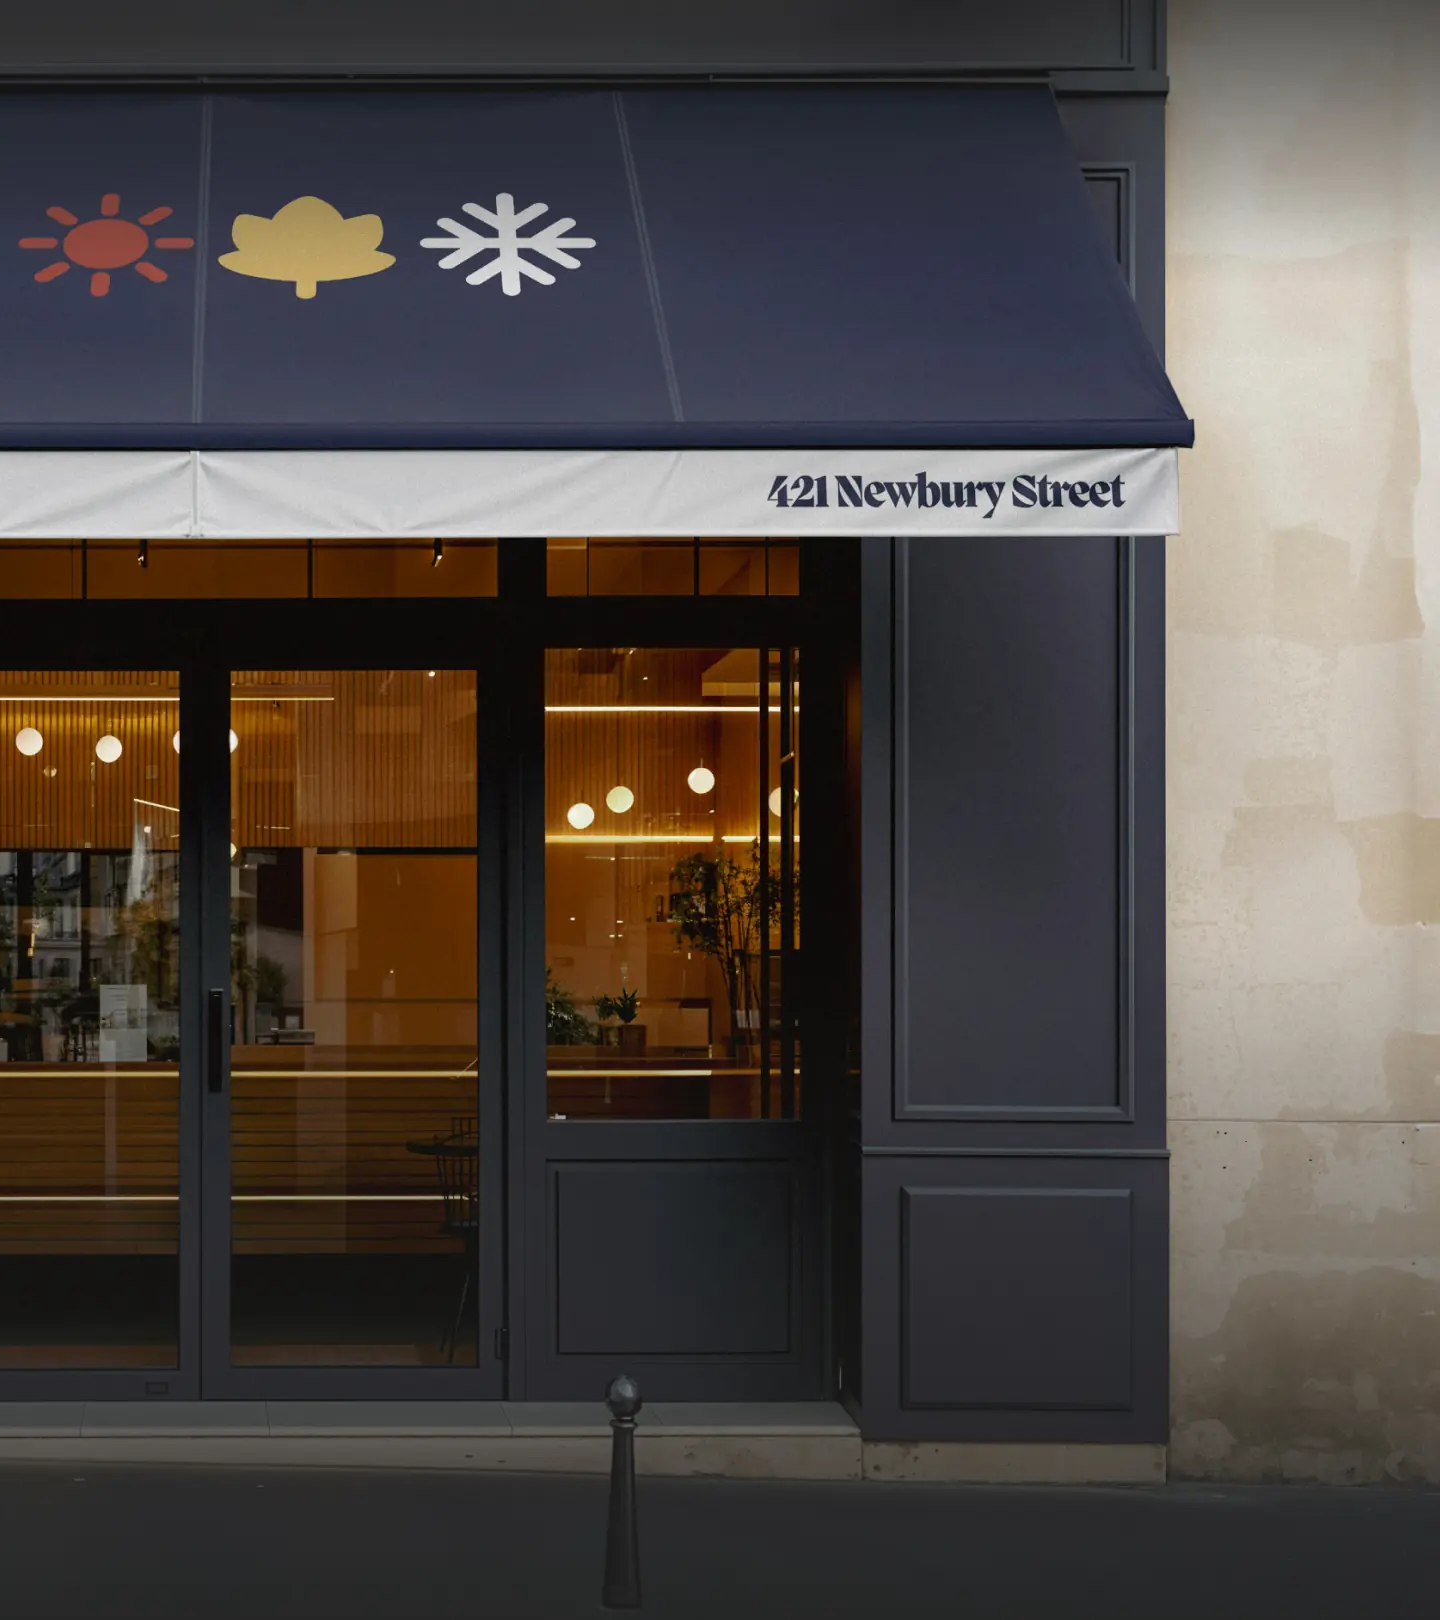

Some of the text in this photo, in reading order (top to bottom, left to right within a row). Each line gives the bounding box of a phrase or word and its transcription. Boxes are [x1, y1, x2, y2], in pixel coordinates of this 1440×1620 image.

[767, 471, 1126, 519] 421 Newbury Street
